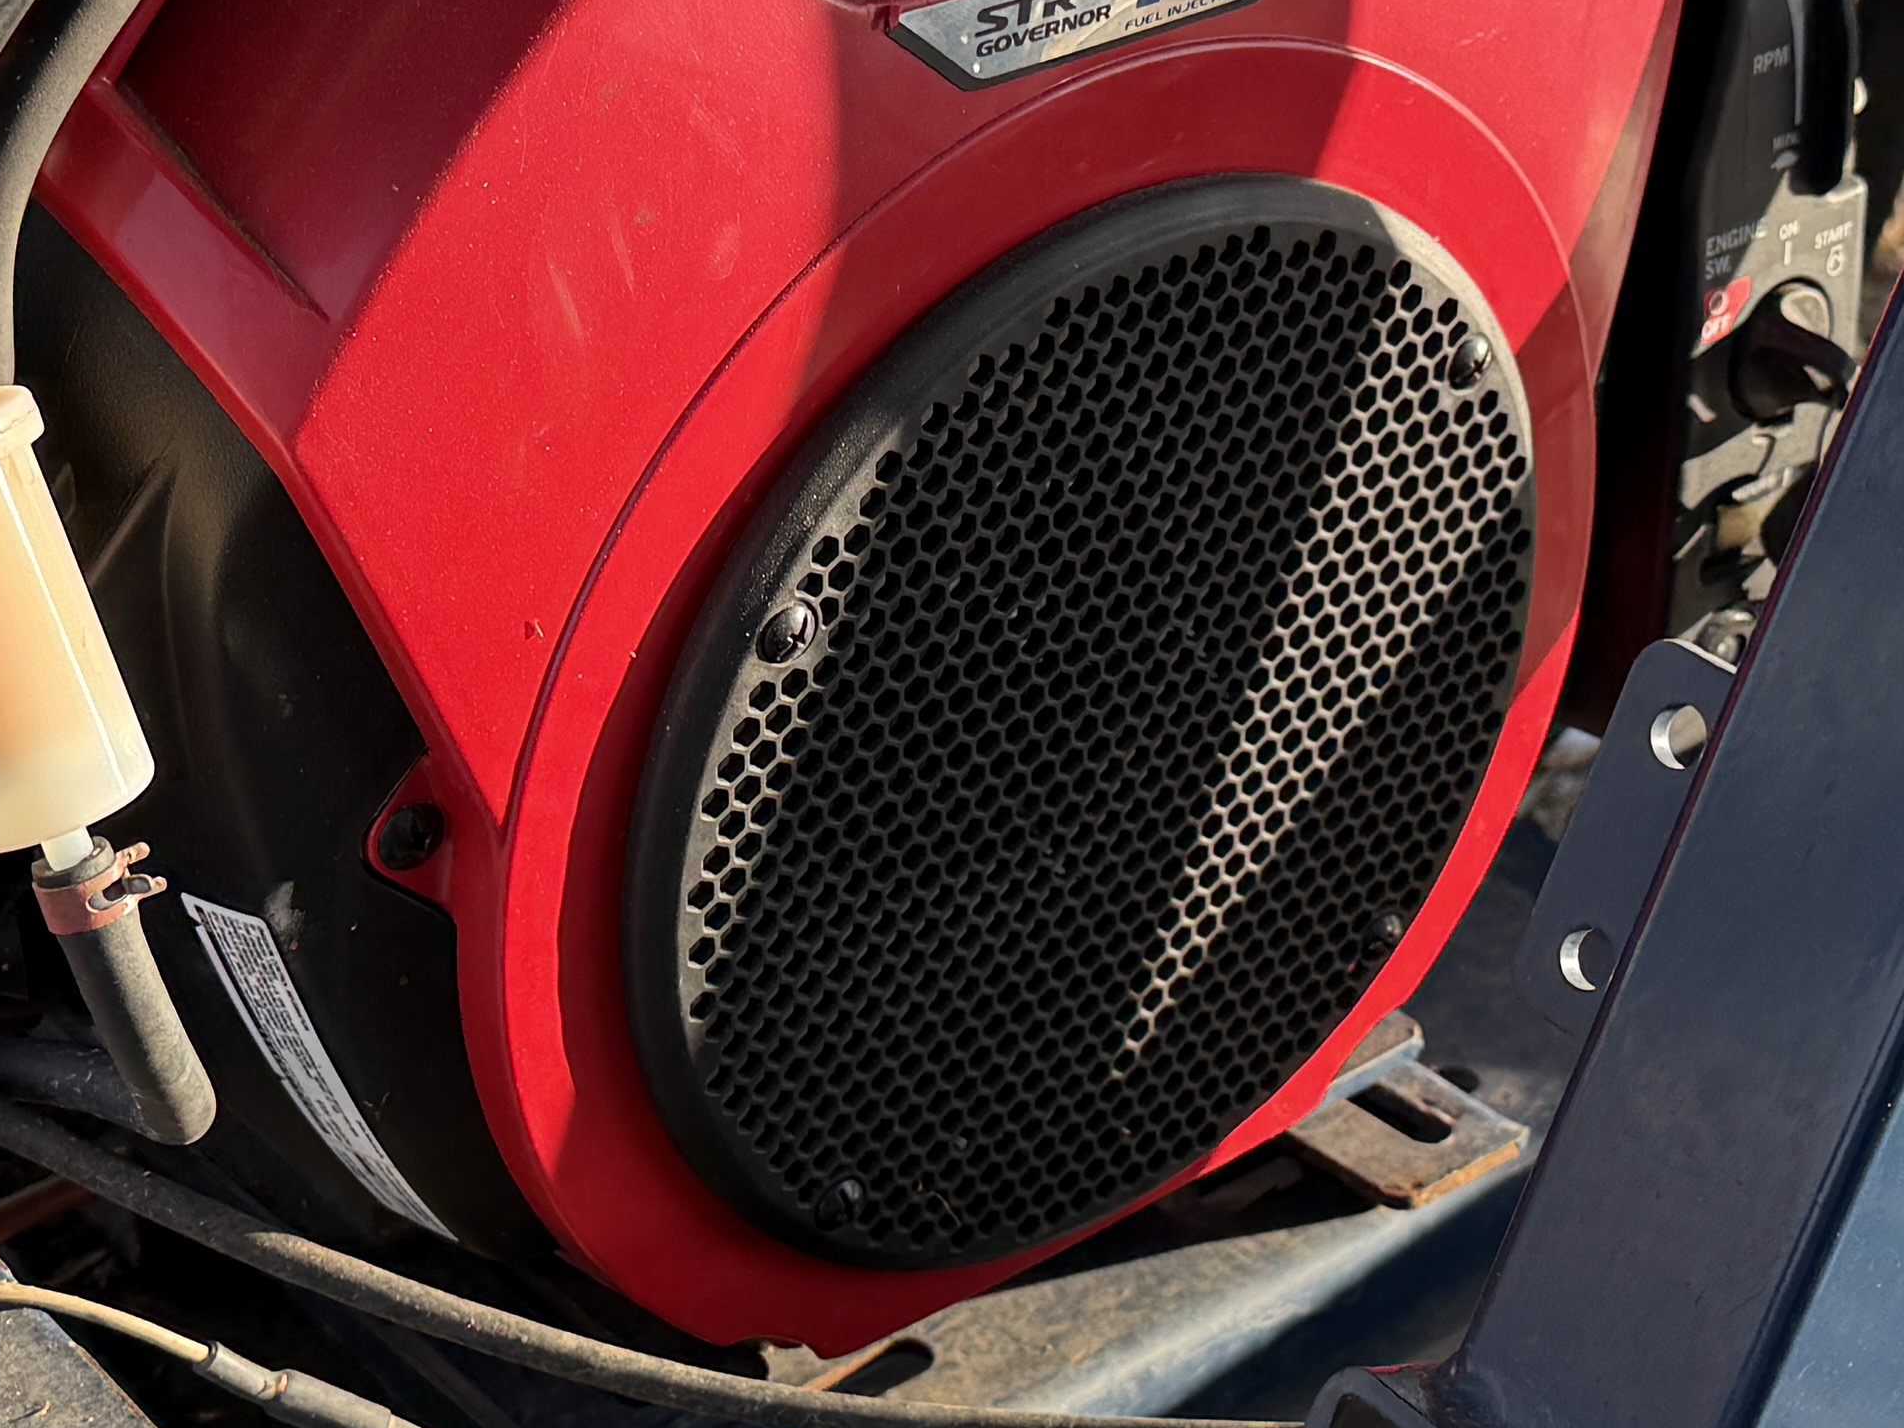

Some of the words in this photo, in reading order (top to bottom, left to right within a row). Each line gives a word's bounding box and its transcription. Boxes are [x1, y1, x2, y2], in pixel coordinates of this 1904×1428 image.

[976, 4, 1112, 58] GOVERNOR
[1124, 12, 1163, 31] FUEL
[1753, 44, 1791, 75] RPM
[1705, 217, 1768, 257] ENGINE
[1779, 220, 1799, 240] ON
[1814, 220, 1853, 250] START
[1701, 312, 1732, 340] OFF
